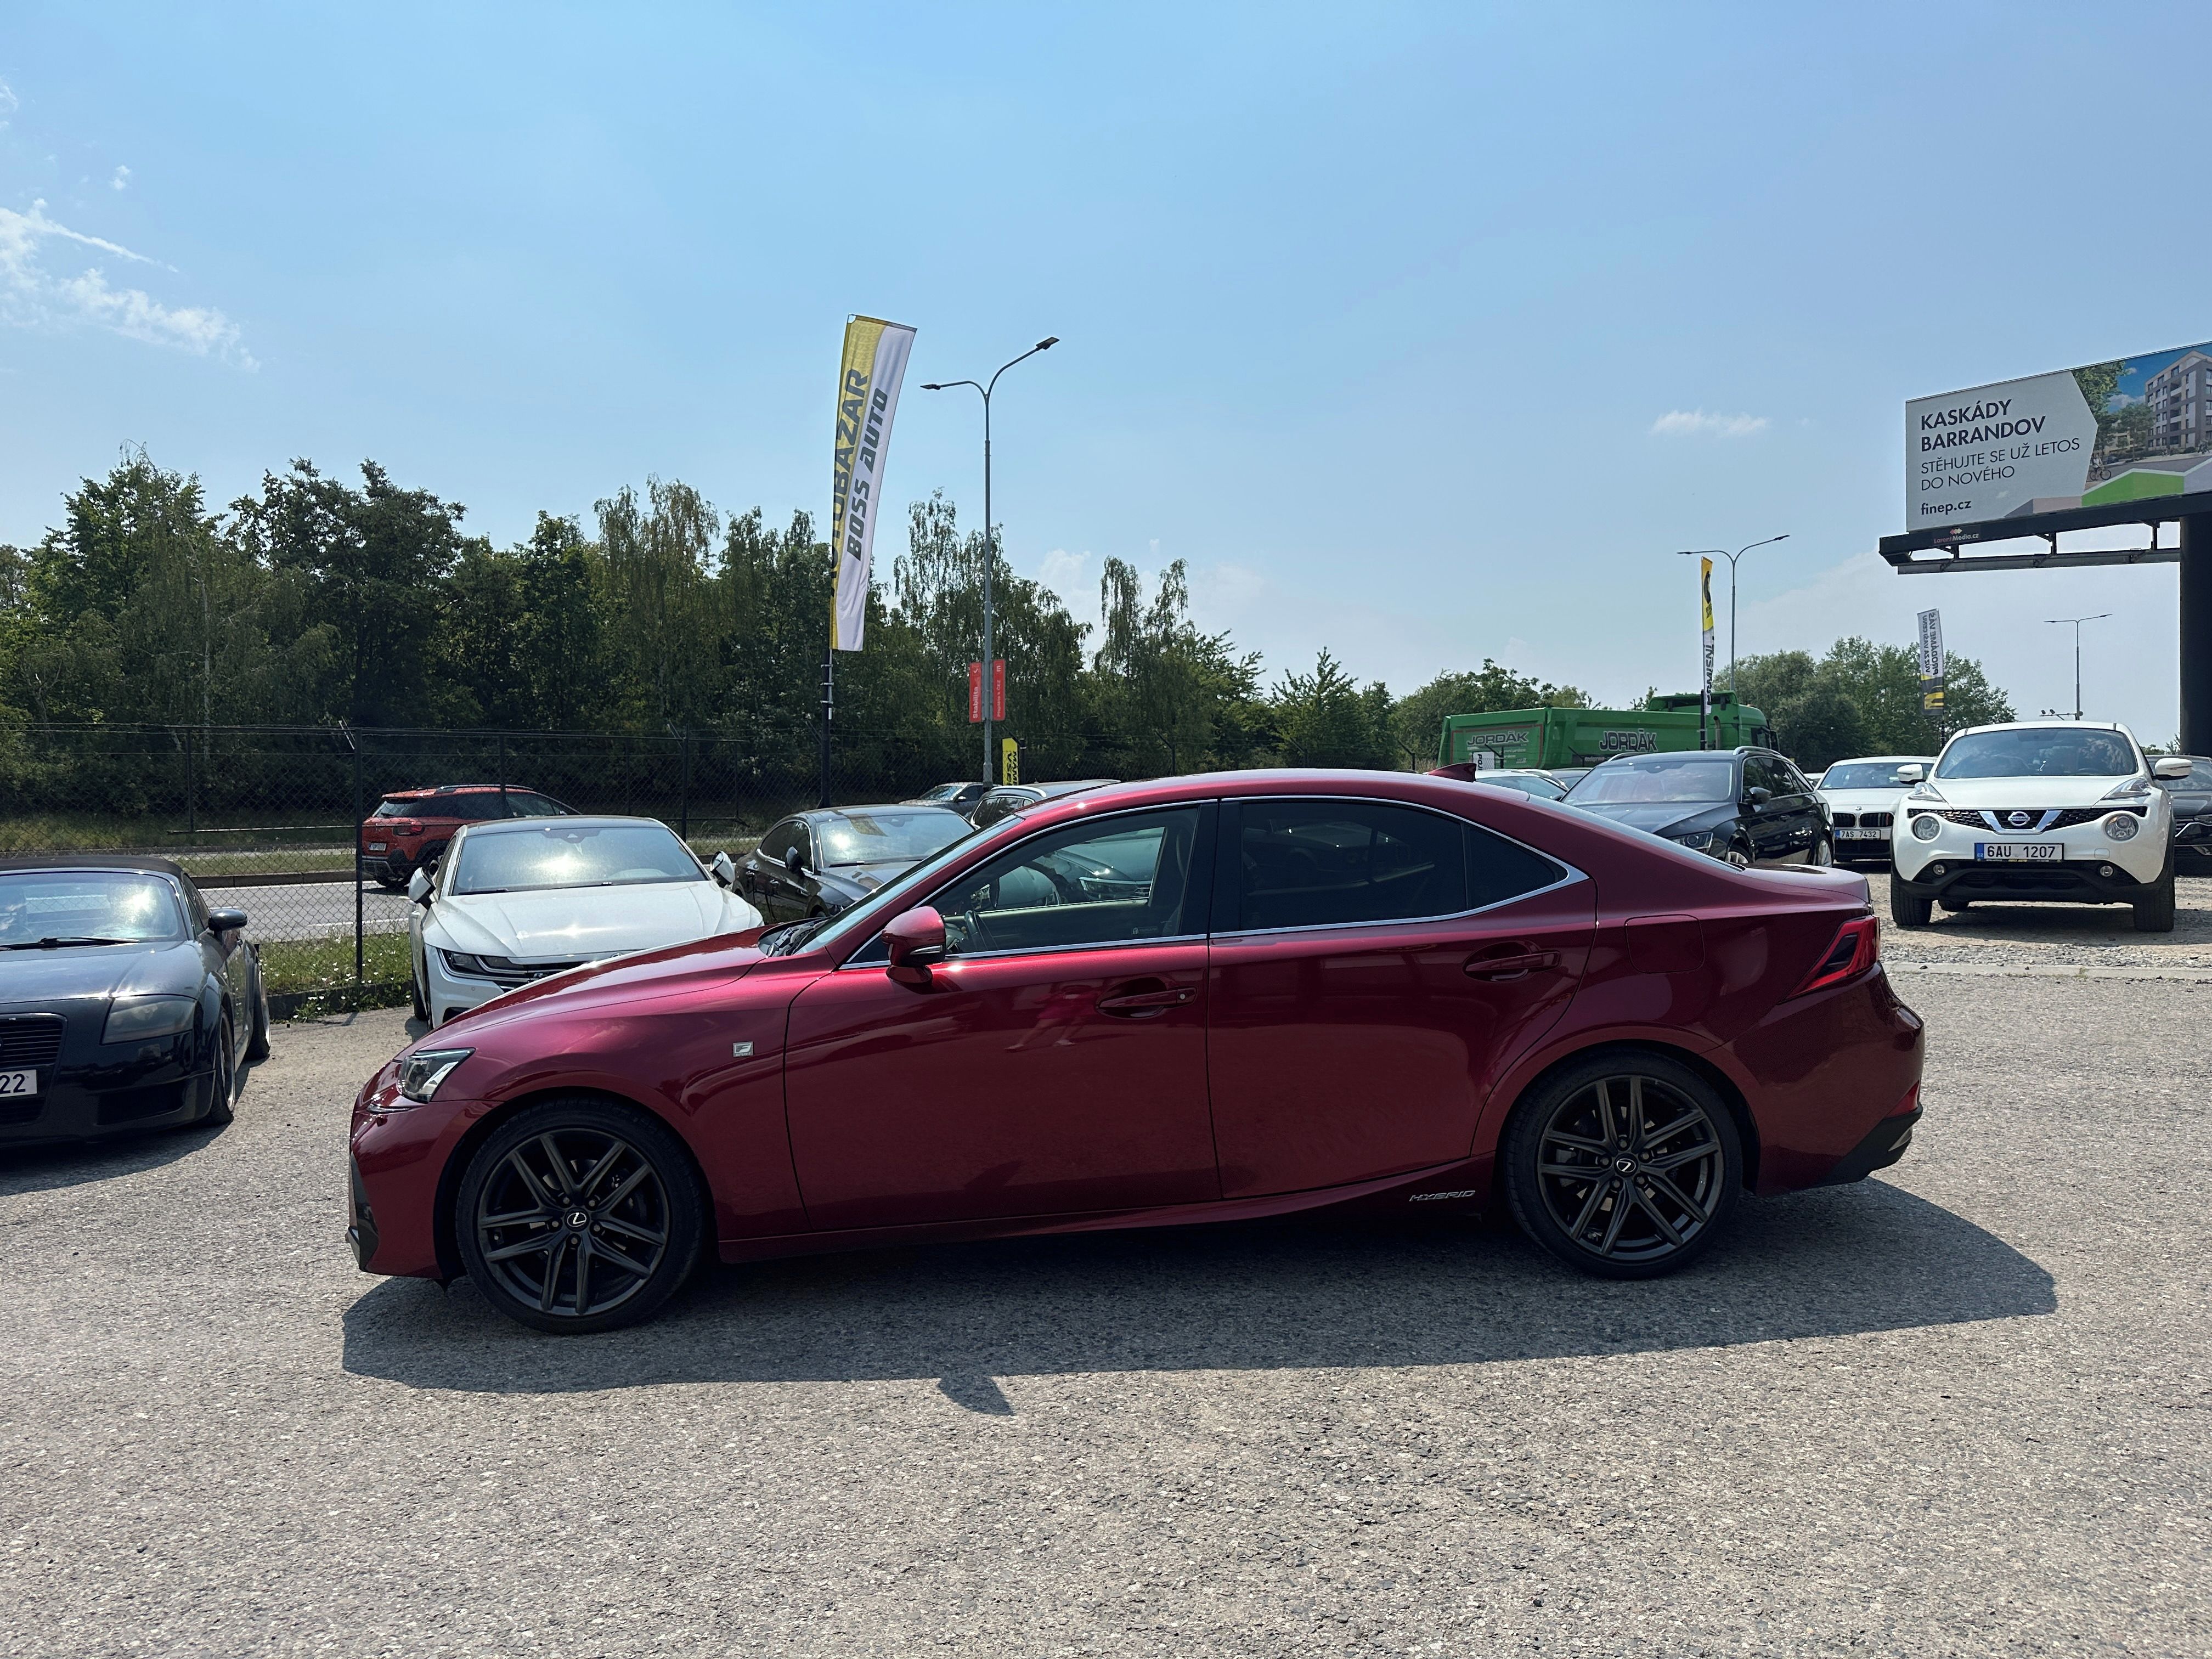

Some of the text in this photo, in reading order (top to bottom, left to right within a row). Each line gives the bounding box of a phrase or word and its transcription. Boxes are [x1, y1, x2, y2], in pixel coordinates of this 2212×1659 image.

[1921, 399, 2012, 430] KASKÁDY
[1922, 416, 2046, 452] BARRANDOV
[1921, 438, 2080, 473] STĚHUJTE SE UŽ LETOS
[847, 478, 870, 561] BOSS
[860, 388, 888, 473] AUTO
[1922, 466, 2015, 490] DO NOVÉHO
[1921, 500, 1972, 515] finep.cz
[1987, 845, 2011, 857] 6AU
[2023, 846, 2055, 858] 1207
[0, 1074, 26, 1094] 22
[1409, 1190, 1476, 1202] HYBRID
